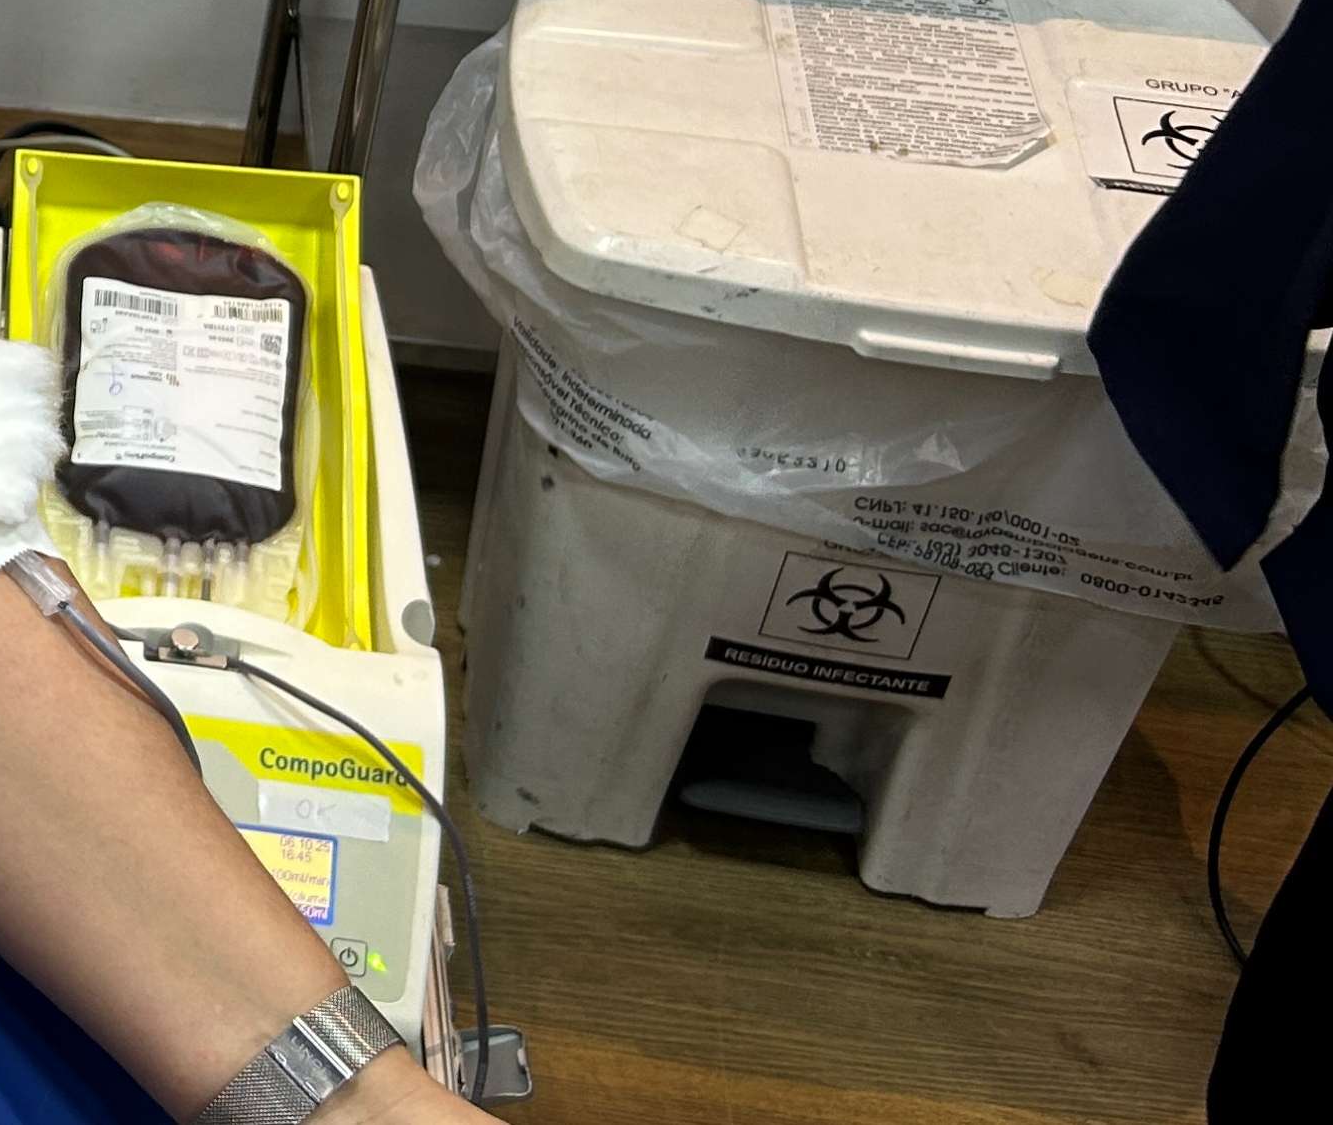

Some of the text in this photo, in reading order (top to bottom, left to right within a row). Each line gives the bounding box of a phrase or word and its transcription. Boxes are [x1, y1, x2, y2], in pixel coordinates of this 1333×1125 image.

[1145, 78, 1218, 97] GRUPO
[561, 369, 652, 441] Indeterminada
[724, 647, 931, 693] RESÍDUO INFECTANTE
[295, 798, 337, 820] OK
